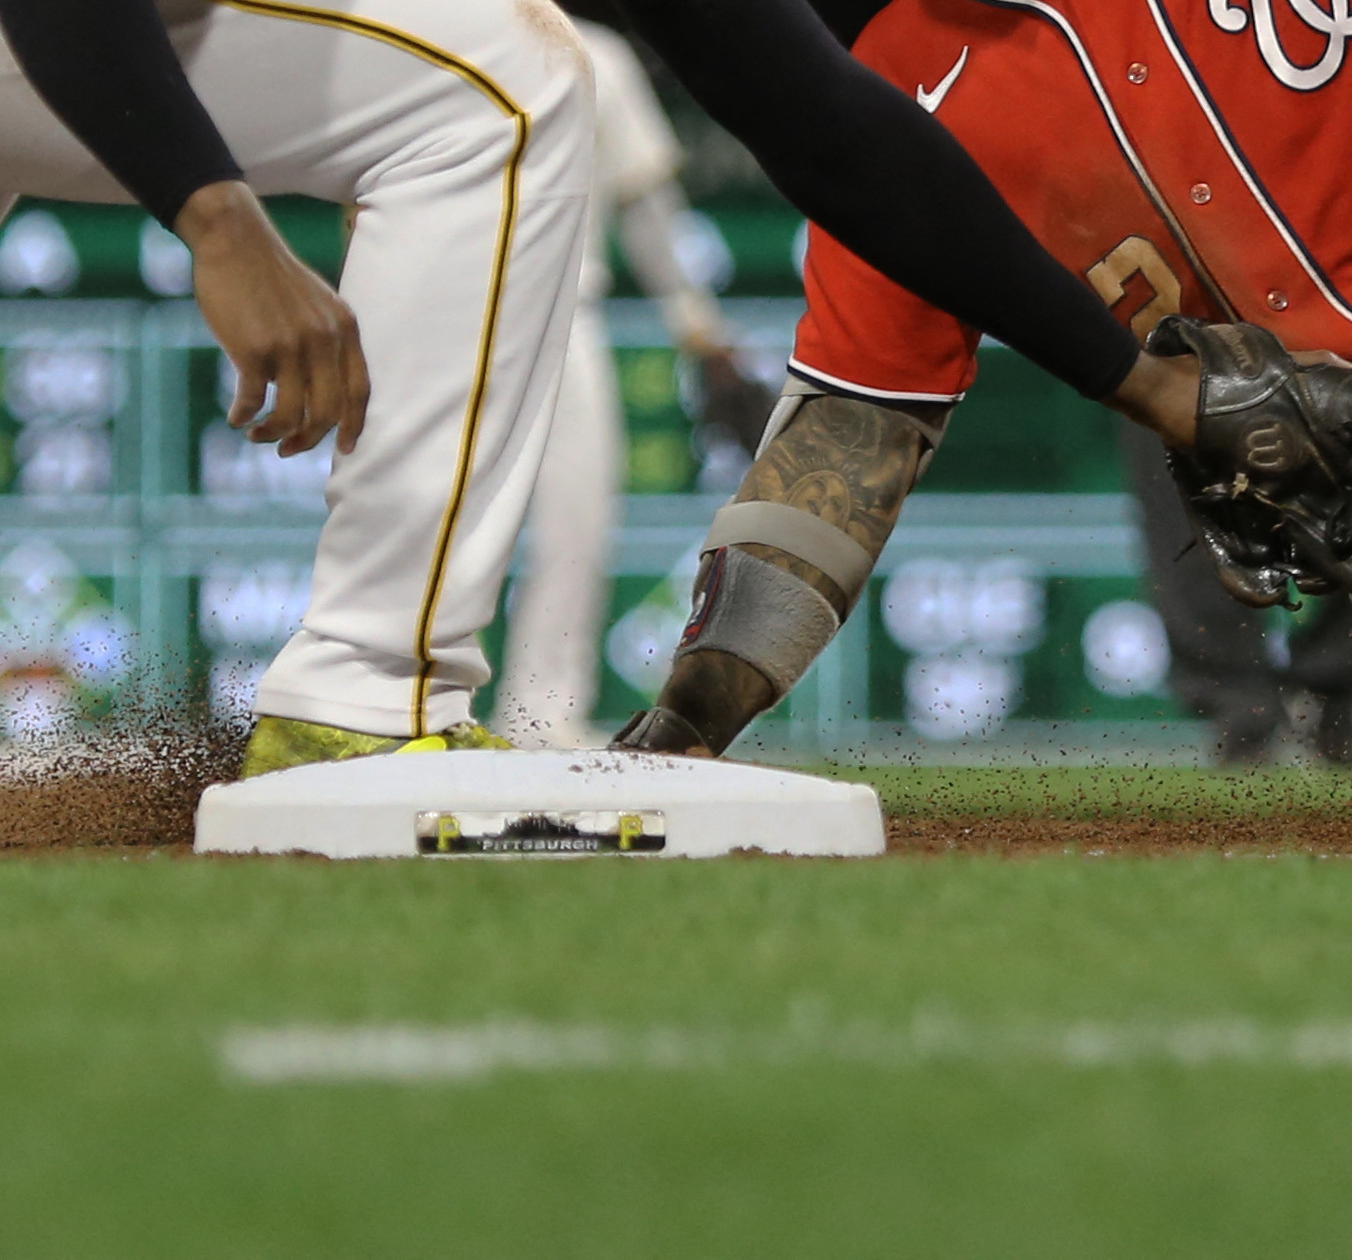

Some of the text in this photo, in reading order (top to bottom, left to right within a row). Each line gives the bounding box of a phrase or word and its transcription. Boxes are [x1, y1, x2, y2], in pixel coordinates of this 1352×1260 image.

[437, 814, 462, 851] P
[480, 838, 599, 851] PITTSBURGH
[618, 814, 644, 851] P
